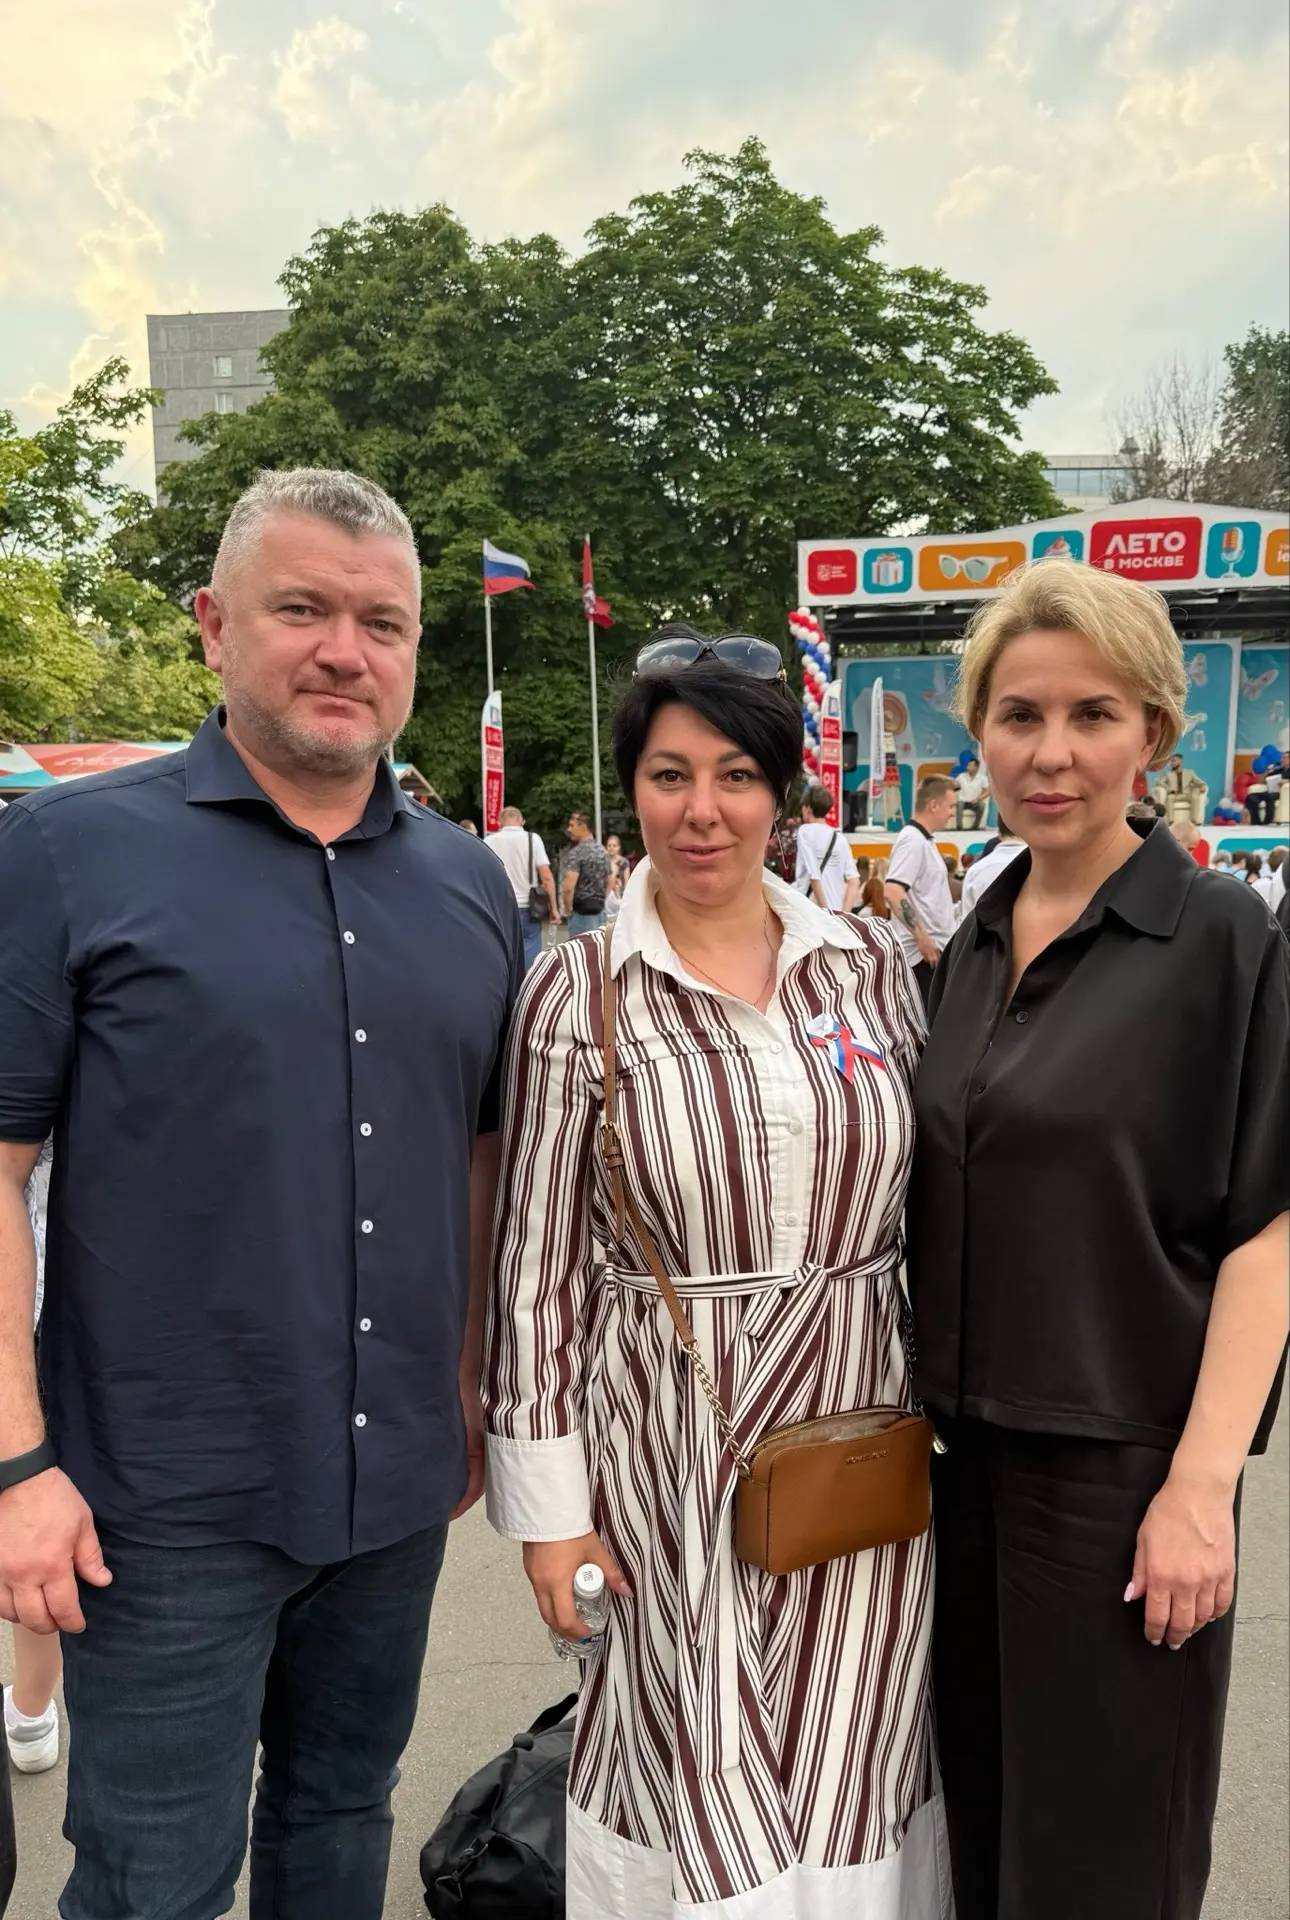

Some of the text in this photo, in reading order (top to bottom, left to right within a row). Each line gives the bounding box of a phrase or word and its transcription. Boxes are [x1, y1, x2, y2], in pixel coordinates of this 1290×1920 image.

[1105, 531, 1186, 555] ЛЕТО
[1103, 555, 1184, 570] В МОСКВЕ
